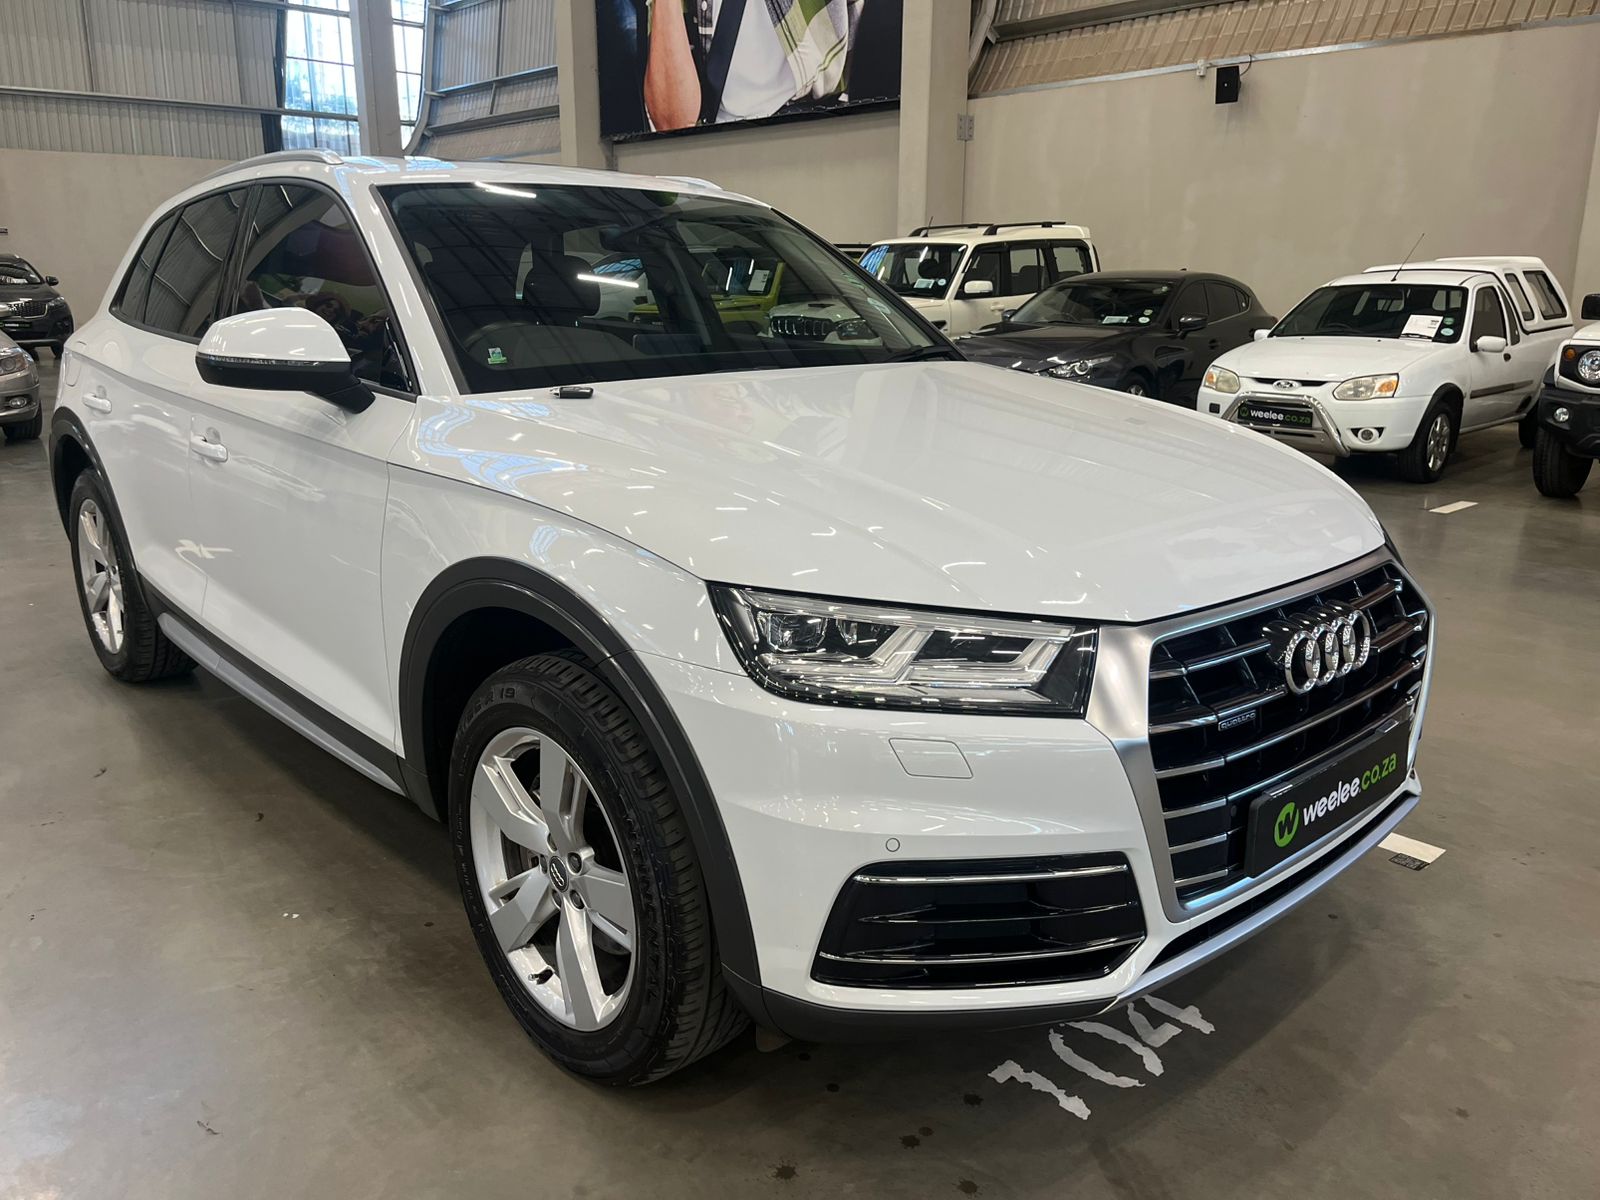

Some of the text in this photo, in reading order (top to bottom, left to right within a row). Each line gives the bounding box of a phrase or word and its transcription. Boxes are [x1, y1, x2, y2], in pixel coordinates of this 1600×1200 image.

[1250, 409, 1311, 424] weelee.co.za
[1220, 711, 1256, 730] quattro
[1302, 752, 1397, 827] weelee.co.za
[987, 994, 1216, 1120] 104
